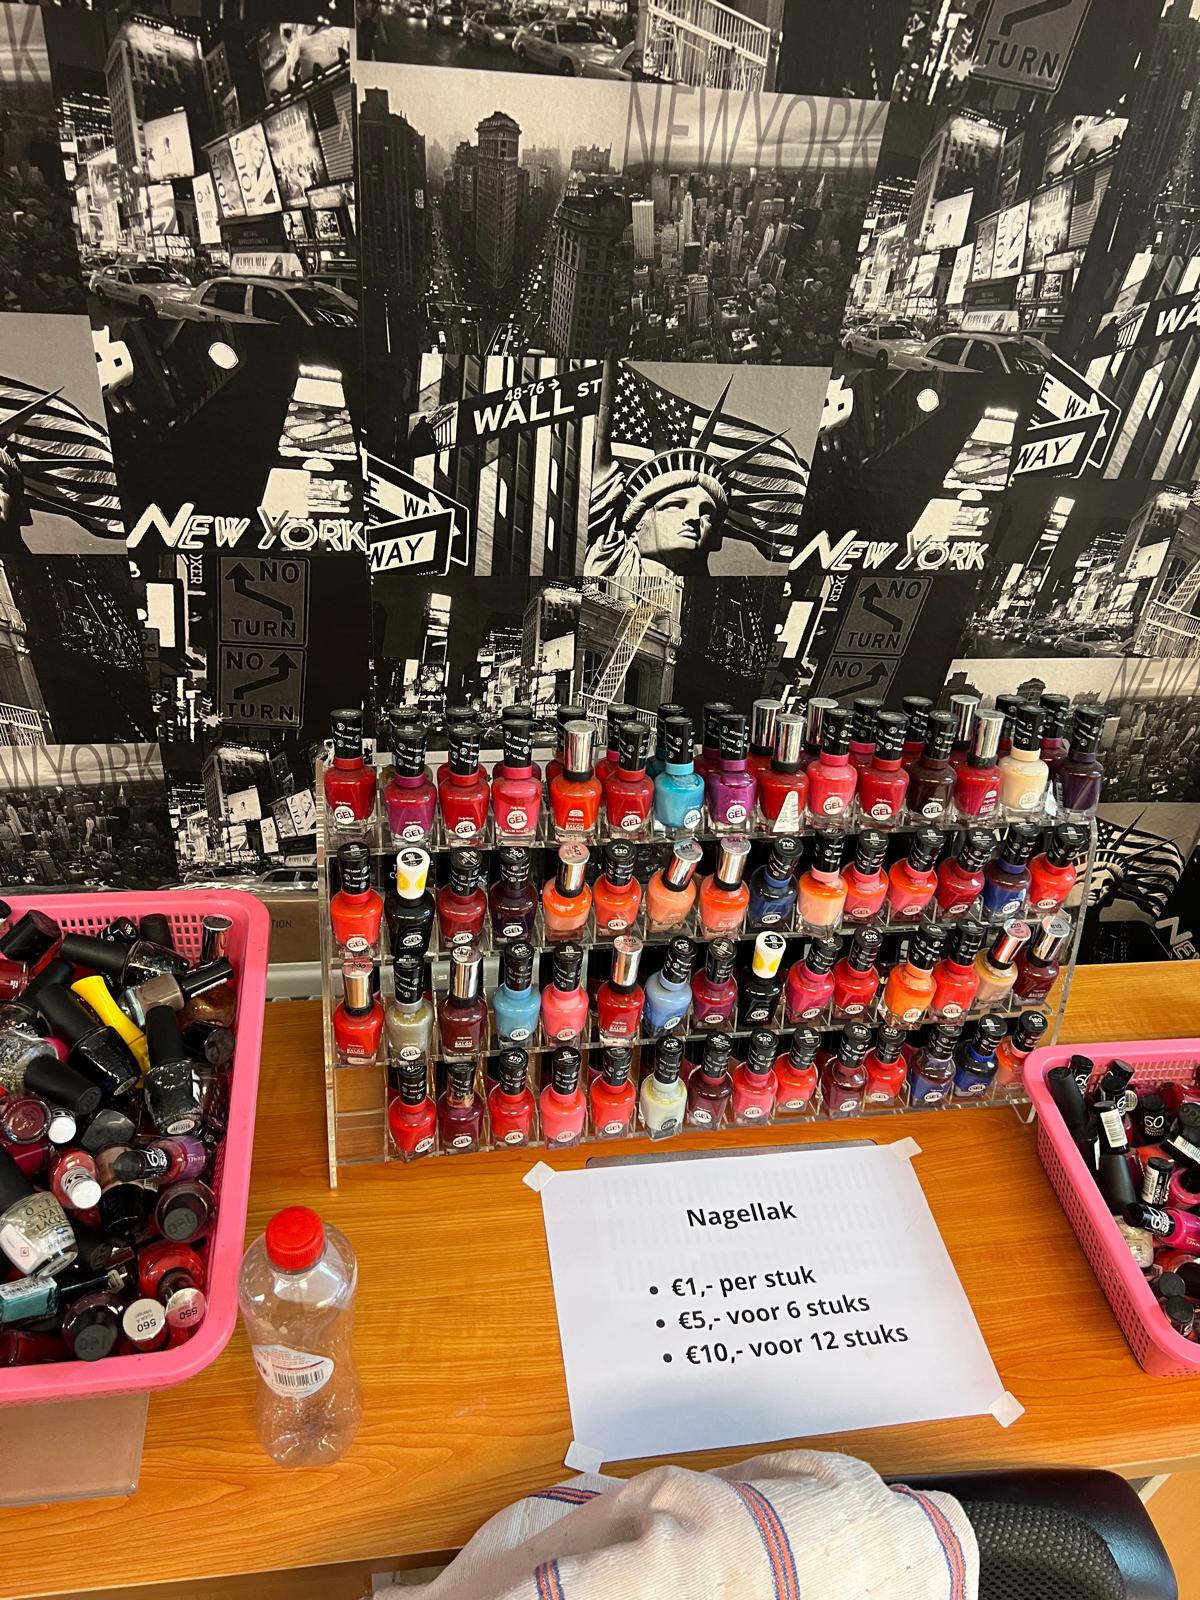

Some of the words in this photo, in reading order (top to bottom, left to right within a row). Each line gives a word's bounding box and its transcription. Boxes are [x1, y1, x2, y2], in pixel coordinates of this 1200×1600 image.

[984, 38, 1060, 79] TURN
[504, 380, 545, 402] 48-76
[473, 389, 575, 435] WALL
[577, 378, 602, 398] ST
[258, 561, 300, 584] NO
[887, 580, 923, 600] NO
[230, 618, 297, 638] TURN
[847, 632, 901, 649] TURN
[226, 651, 264, 671] NO
[830, 661, 863, 678] NO
[1104, 657, 1200, 705] NEW
[225, 703, 294, 721] TURN
[824, 801, 843, 810] GEL
[335, 810, 354, 820] GEL
[728, 811, 745, 819] GEL
[872, 808, 892, 816] GEL
[923, 807, 943, 815] GEL
[508, 814, 527, 824] GEL
[622, 817, 641, 826] GEL
[685, 814, 701, 823] GEL
[404, 828, 424, 838] GEL
[456, 825, 476, 834] GEL
[1003, 903, 1019, 913] GEL
[271, 919, 292, 929] TION
[504, 927, 522, 935] GEL
[348, 940, 368, 948] GEL
[403, 935, 422, 944] GEL
[752, 1011, 768, 1019] GEL
[803, 1009, 820, 1017] GEL
[904, 1011, 921, 1020] GEL
[944, 1007, 962, 1015] GEL
[664, 1017, 681, 1028] GEL
[511, 1030, 528, 1038] GEL
[558, 1031, 575, 1039] GEL
[402, 1049, 420, 1058] GEL
[842, 1102, 855, 1110] GEL
[695, 1112, 711, 1120] GEL
[1144, 1115, 1164, 1128] 60
[606, 1124, 622, 1132] GEL
[506, 1133, 522, 1141] GEL
[558, 1132, 574, 1140] GEL
[416, 1140, 432, 1150] GEL
[453, 1137, 471, 1146] GEL
[687, 1202, 796, 1229] Nagellak
[1148, 1206, 1161, 1230] 60
[672, 1278, 712, 1297] €1,-
[720, 1276, 756, 1297] per
[765, 1266, 816, 1287] stuk
[178, 1306, 198, 1320] 550
[679, 1311, 720, 1330] €5,-
[727, 1307, 779, 1324] voor
[787, 1301, 800, 1318] 6
[807, 1295, 869, 1316] stuks
[137, 1318, 157, 1333] 560
[686, 1343, 742, 1364] €10,-
[749, 1339, 802, 1356] voor
[811, 1332, 838, 1350] 12
[844, 1325, 907, 1347] stuks
